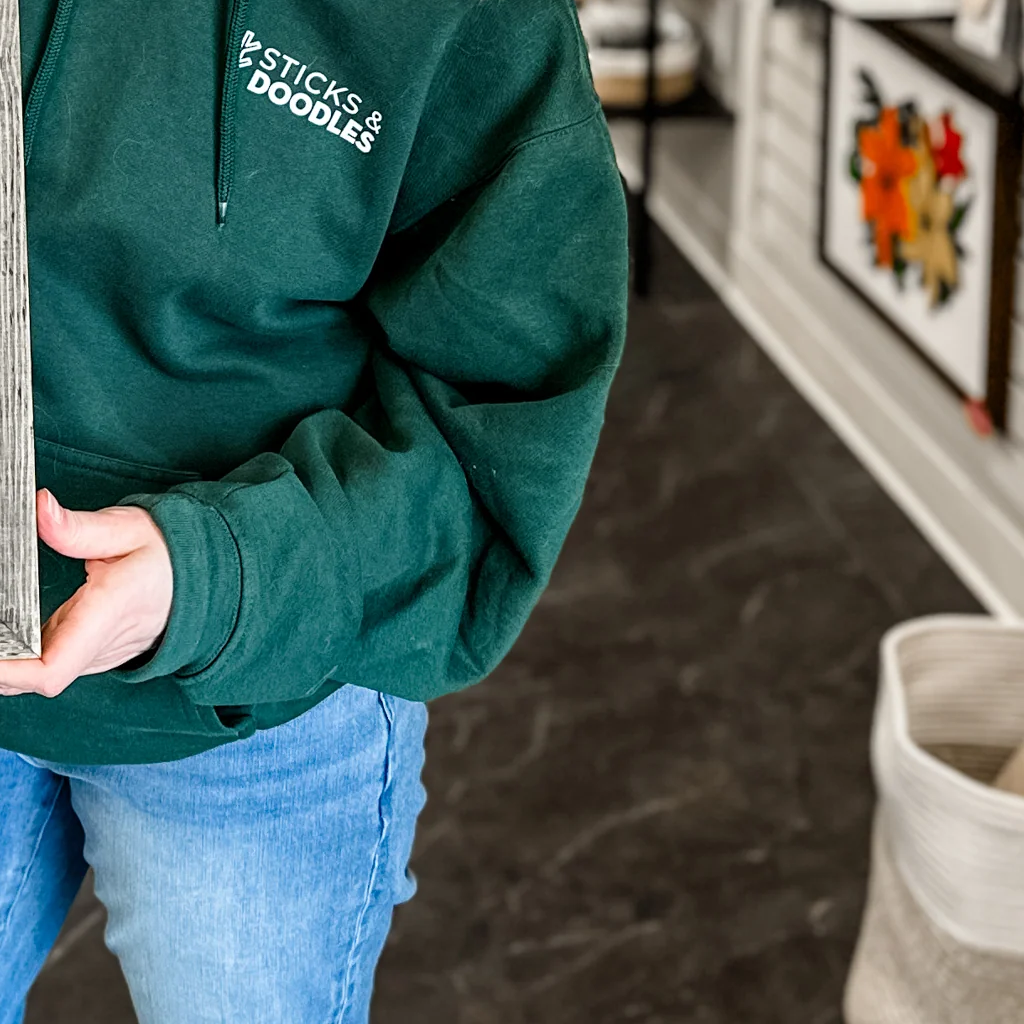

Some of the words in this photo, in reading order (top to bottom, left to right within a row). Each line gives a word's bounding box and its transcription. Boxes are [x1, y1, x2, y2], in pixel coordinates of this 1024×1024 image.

[246, 68, 375, 154] DOODLES
[259, 47, 363, 115] STICKS
[364, 110, 383, 135] &
